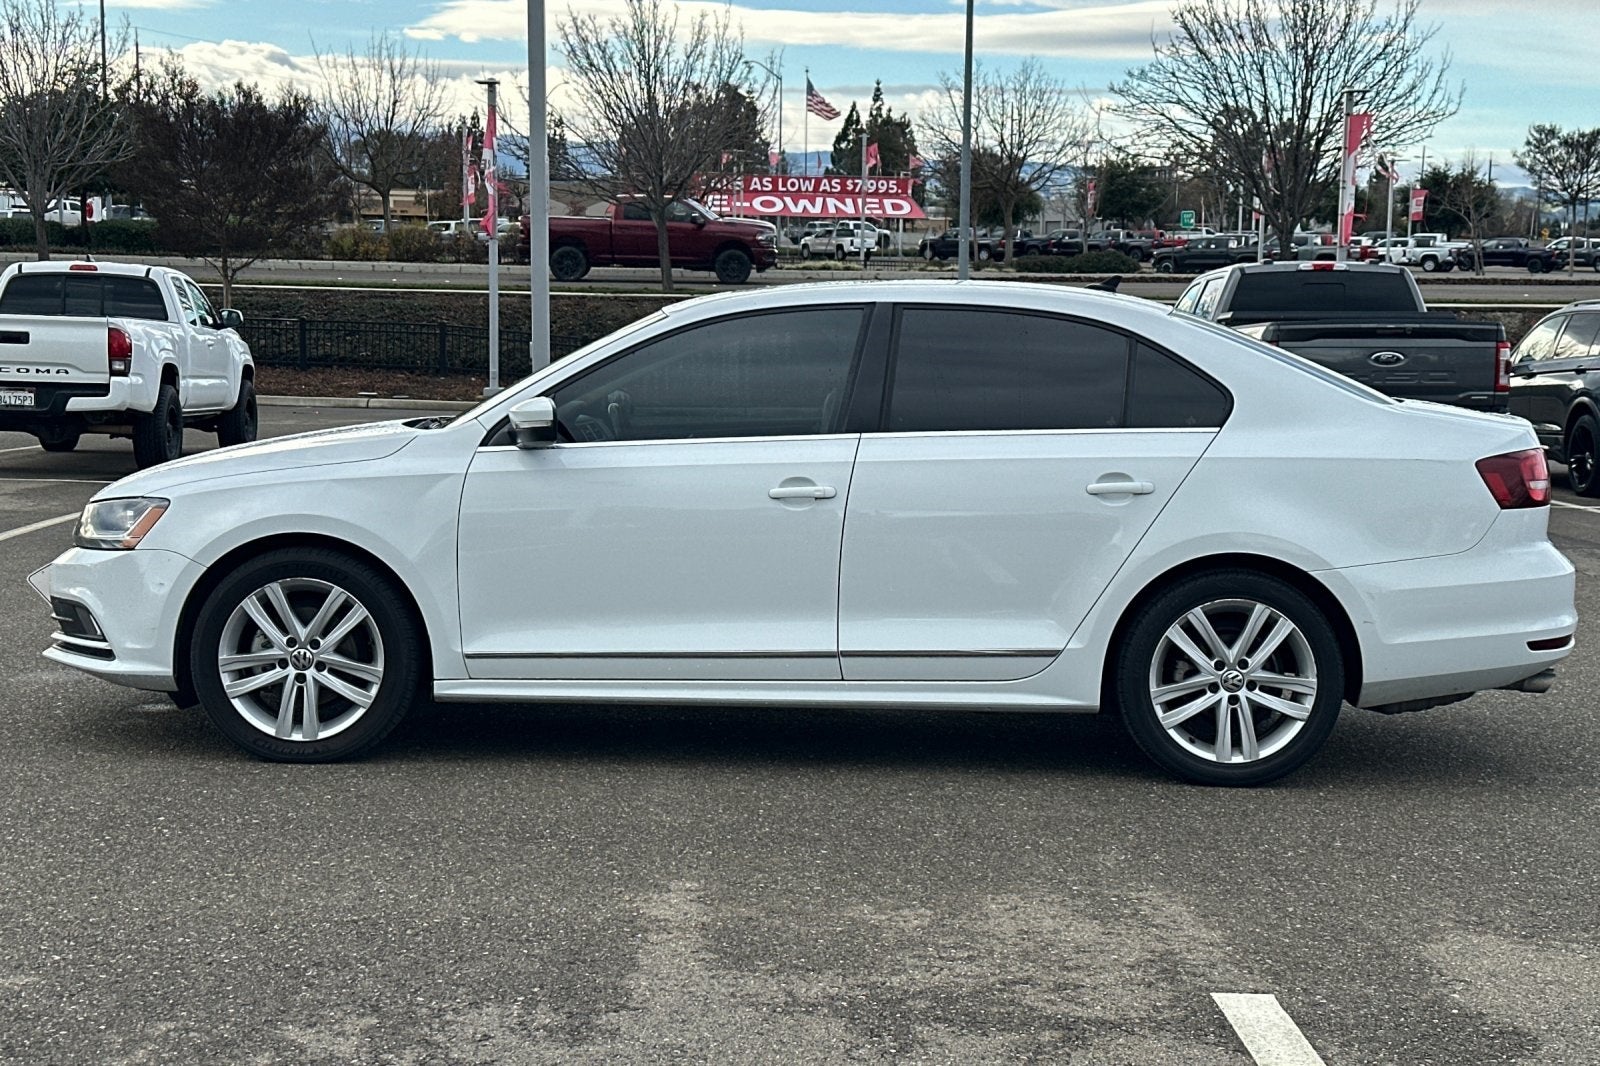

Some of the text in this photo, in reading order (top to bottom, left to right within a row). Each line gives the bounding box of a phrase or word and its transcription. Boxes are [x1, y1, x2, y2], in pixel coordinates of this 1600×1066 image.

[749, 177, 773, 191] AS
[778, 178, 815, 192] LOW
[819, 179, 841, 193] AS
[846, 179, 902, 194] $7995.
[705, 194, 912, 215] E-OWNED
